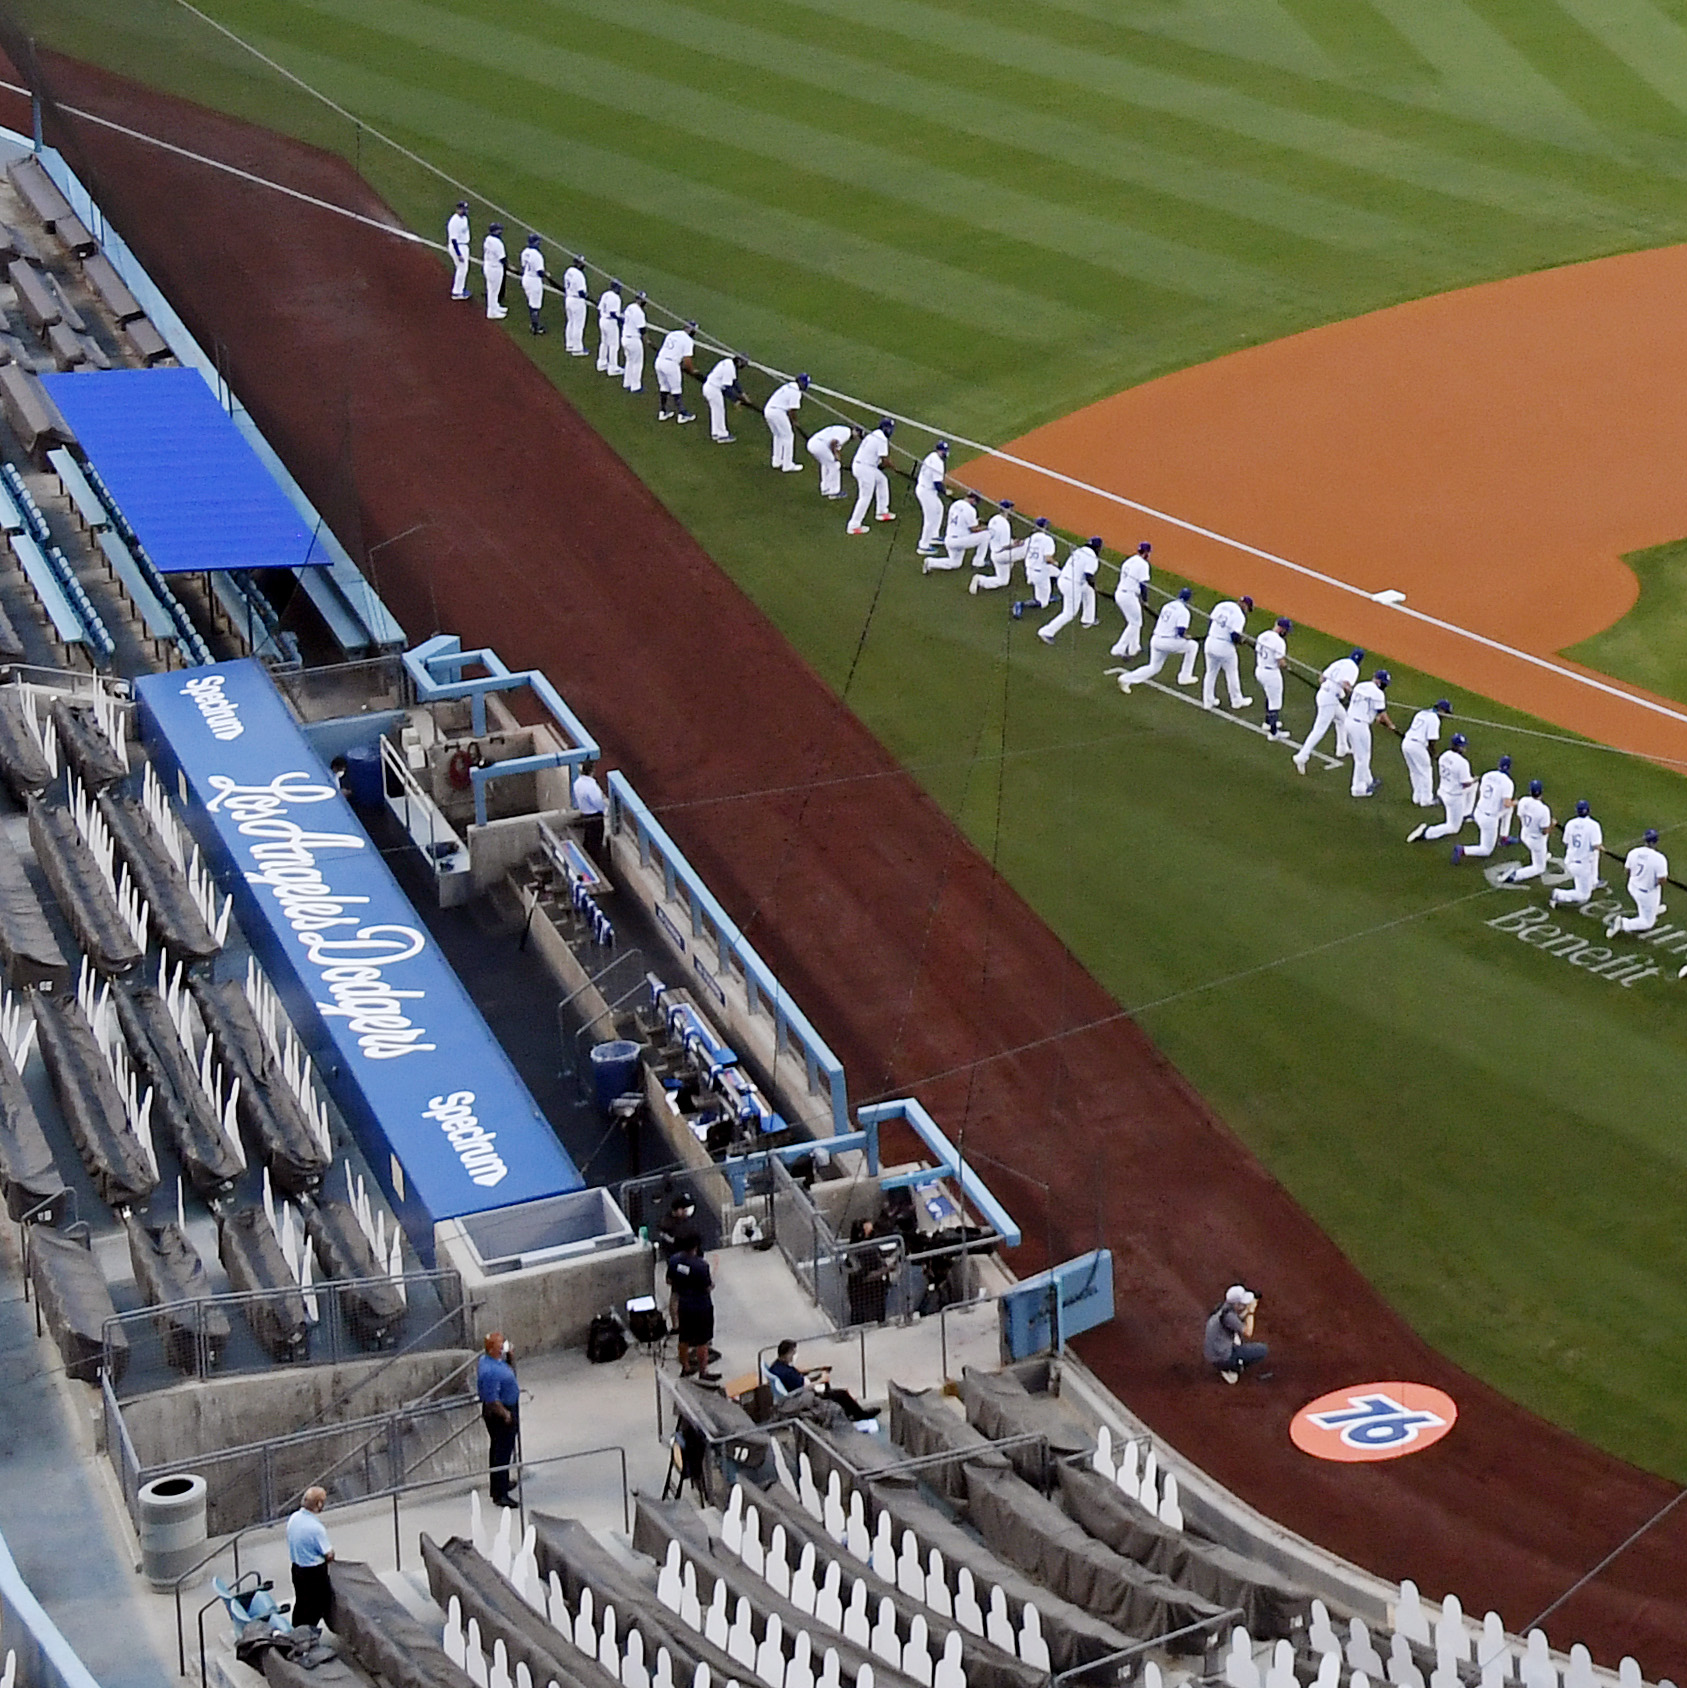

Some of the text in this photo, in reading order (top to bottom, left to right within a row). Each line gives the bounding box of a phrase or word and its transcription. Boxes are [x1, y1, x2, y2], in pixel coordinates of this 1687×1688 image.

[179, 674, 244, 741] Spectrum
[207, 772, 436, 1060] Los Angeles Dodgers
[421, 1091, 509, 1187] Spectrum
[1307, 1393, 1446, 1450] 76
